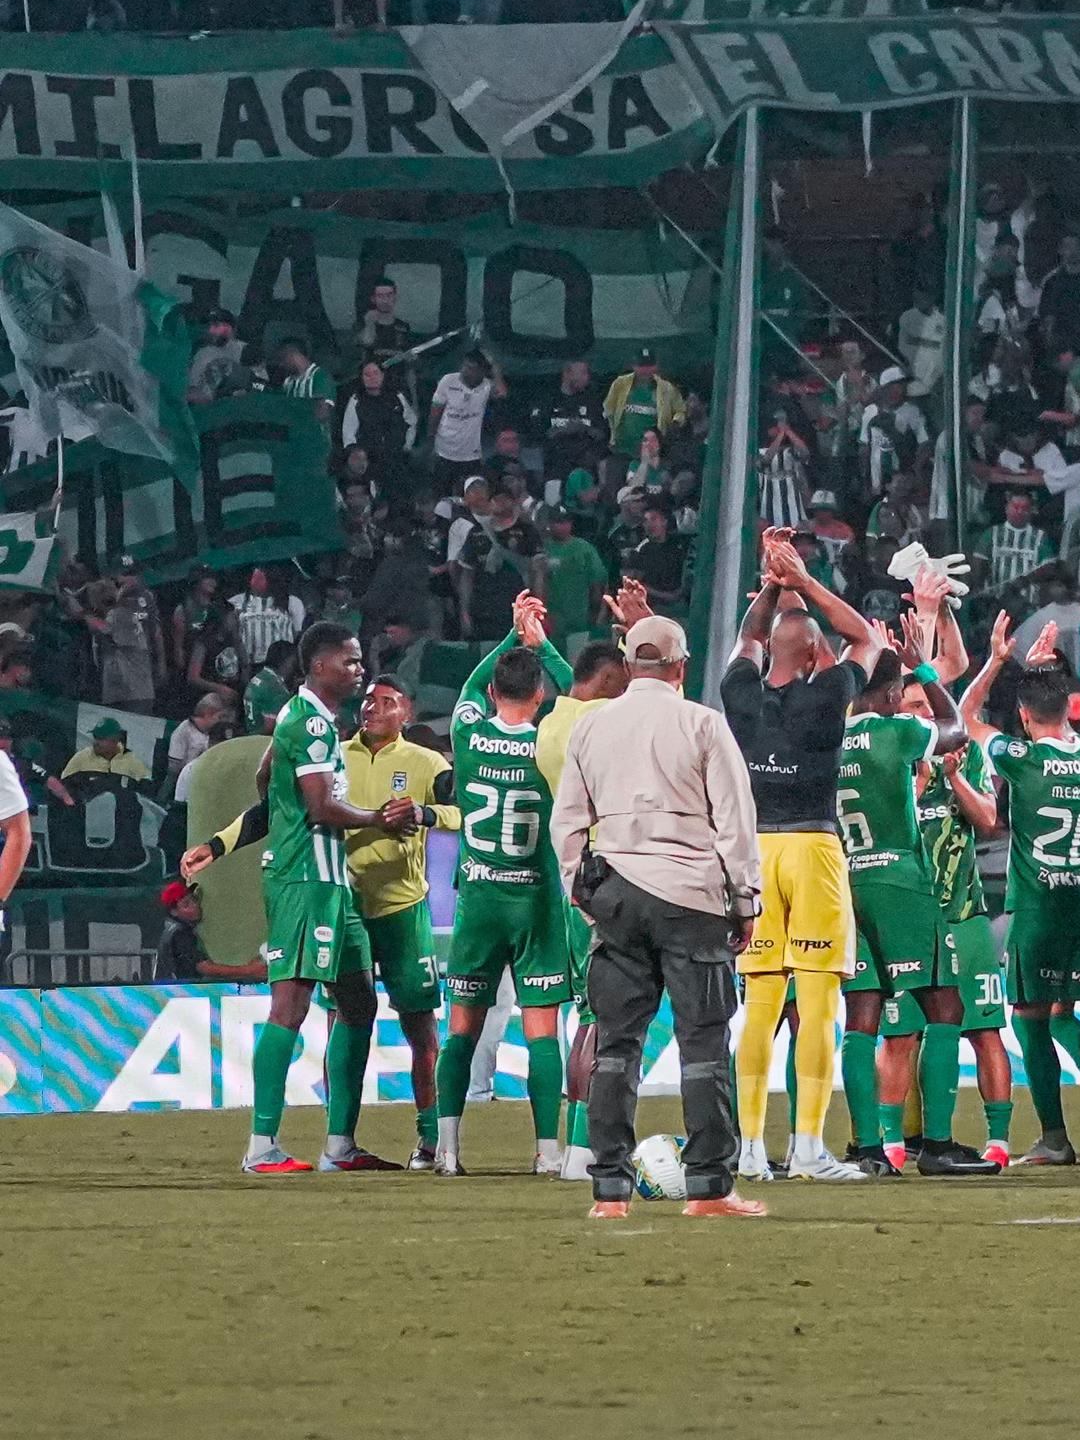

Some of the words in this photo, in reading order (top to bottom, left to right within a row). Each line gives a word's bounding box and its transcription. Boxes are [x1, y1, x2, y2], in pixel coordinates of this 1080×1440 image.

[690, 31, 840, 105] EL
[0, 67, 672, 160] MILAGRSA
[749, 762, 799, 774] CATAPULT
[464, 782, 542, 857] 26
[975, 974, 1000, 1005] 30
